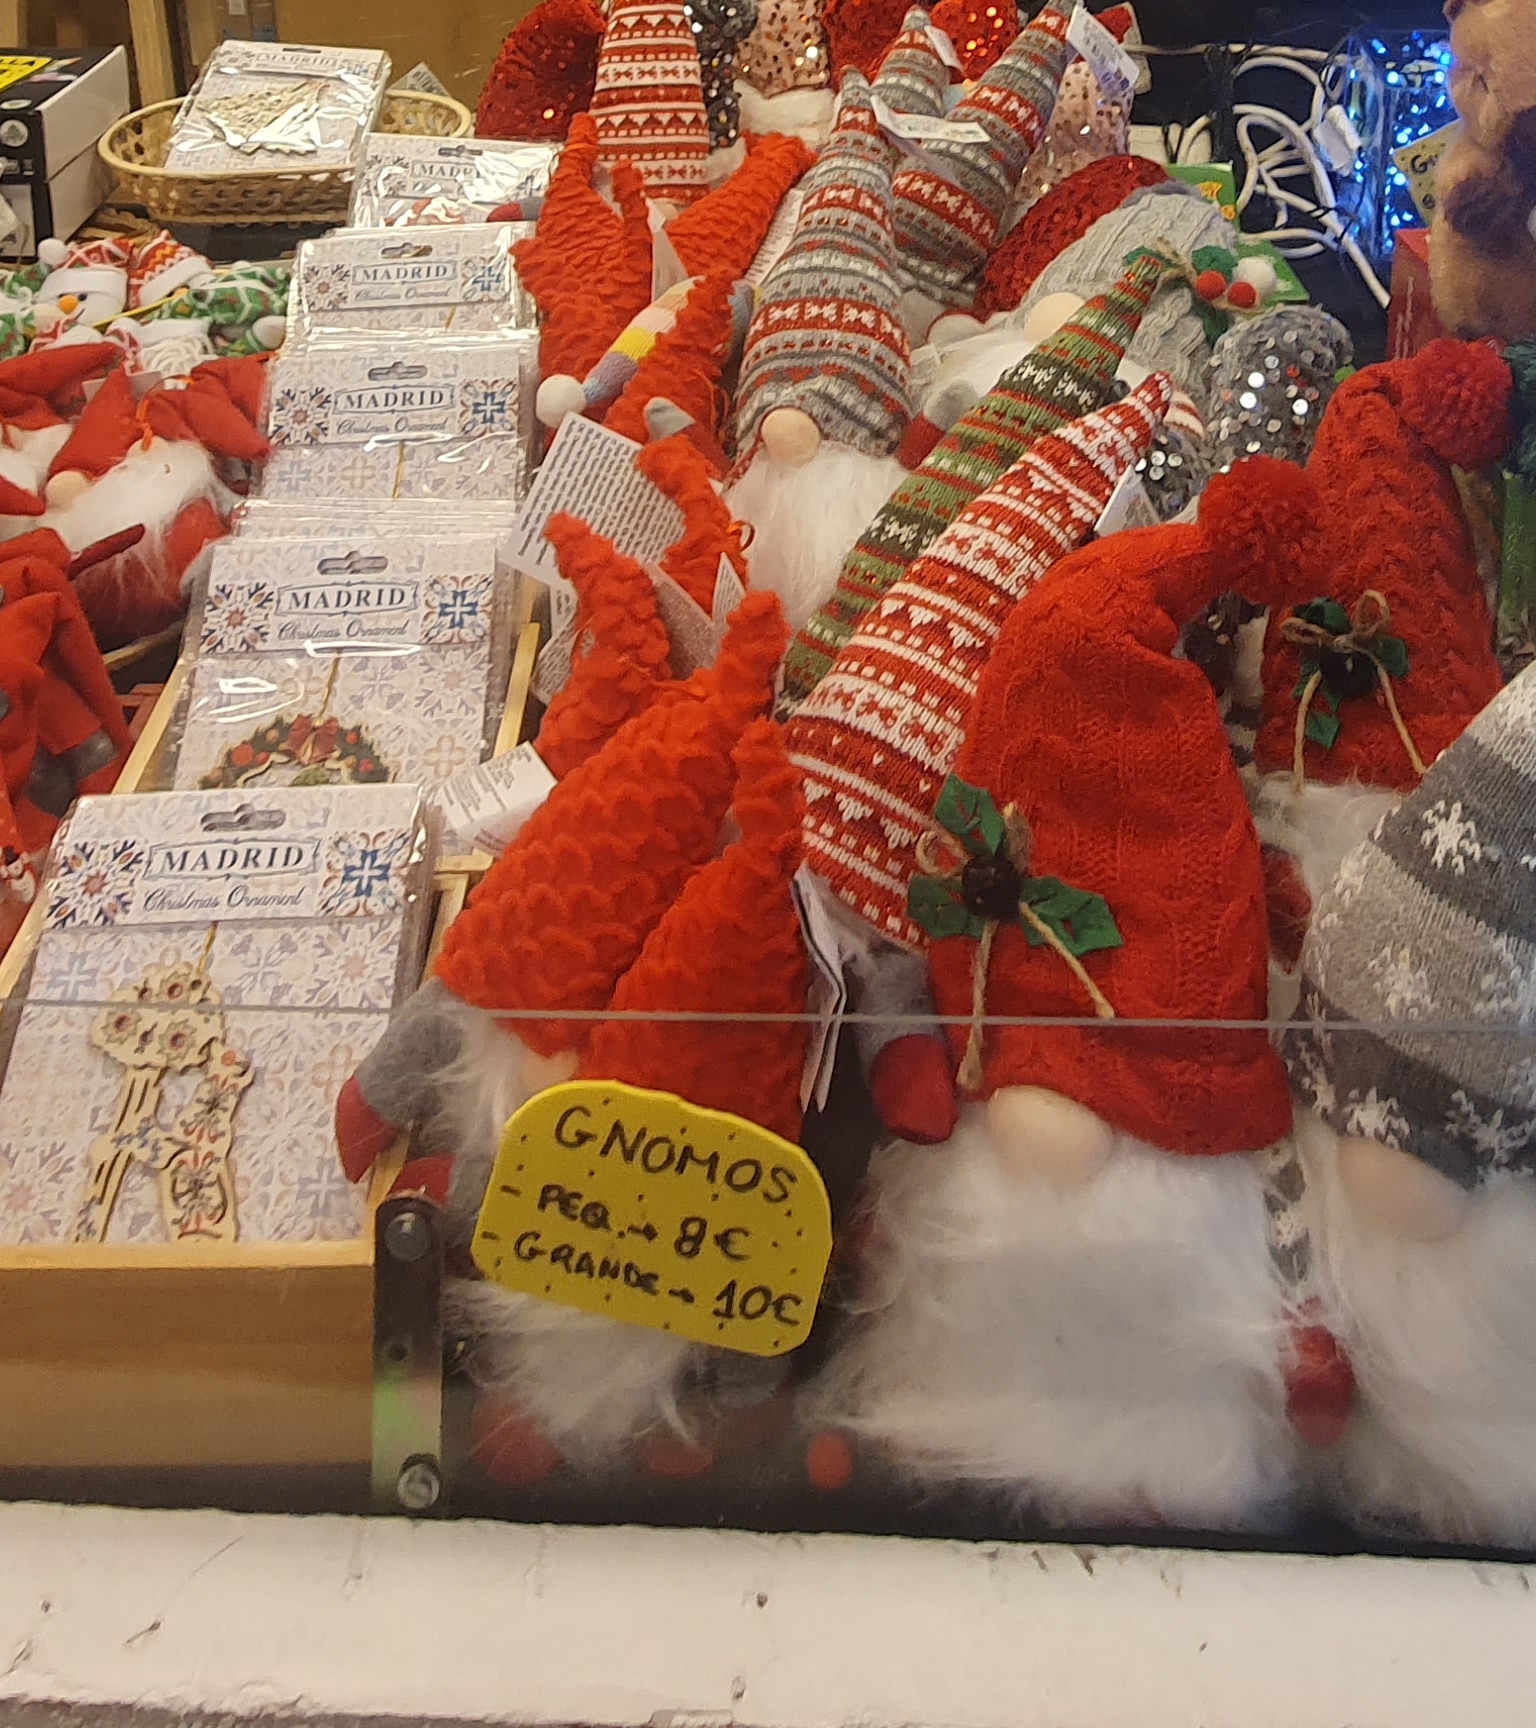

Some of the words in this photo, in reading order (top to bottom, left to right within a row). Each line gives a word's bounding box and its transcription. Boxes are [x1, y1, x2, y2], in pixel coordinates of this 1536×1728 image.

[418, 162, 482, 178] MADR
[362, 264, 448, 281] MADRID
[343, 388, 445, 410] MADRID
[336, 419, 391, 435] Christmas
[394, 416, 448, 433] Ornament
[288, 586, 406, 610] MADRID
[277, 622, 341, 641] Christmas
[345, 619, 410, 638] Ornament
[160, 846, 305, 873] MADRID
[143, 886, 220, 912] Christmas
[225, 884, 307, 909] Ornament
[554, 1104, 799, 1204] GNOMOS
[673, 1215, 753, 1262] 8€
[514, 1230, 661, 1297] GRANDE
[712, 1278, 803, 1327] 10€
